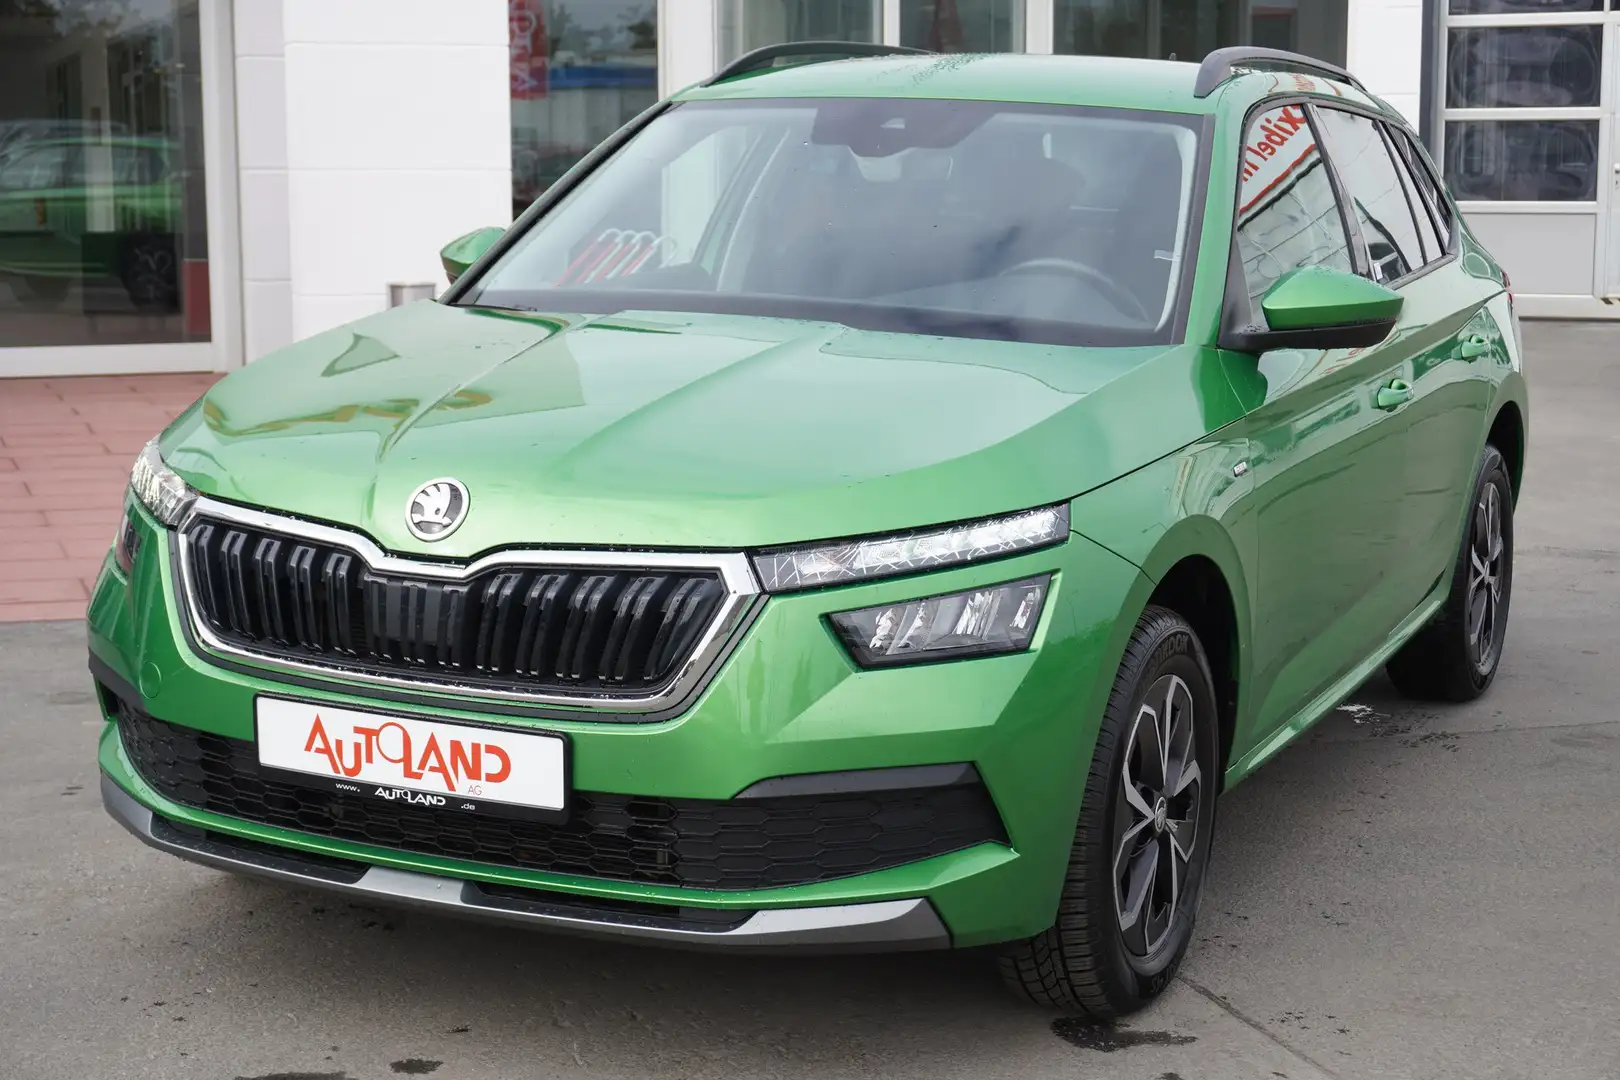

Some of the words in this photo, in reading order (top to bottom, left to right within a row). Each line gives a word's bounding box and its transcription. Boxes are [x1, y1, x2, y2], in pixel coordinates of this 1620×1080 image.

[304, 713, 512, 792] AUTOLAND
[335, 782, 361, 793] www.
[374, 786, 446, 807] AUTOLAND
[460, 802, 476, 811] .de
[467, 785, 483, 796] AG
